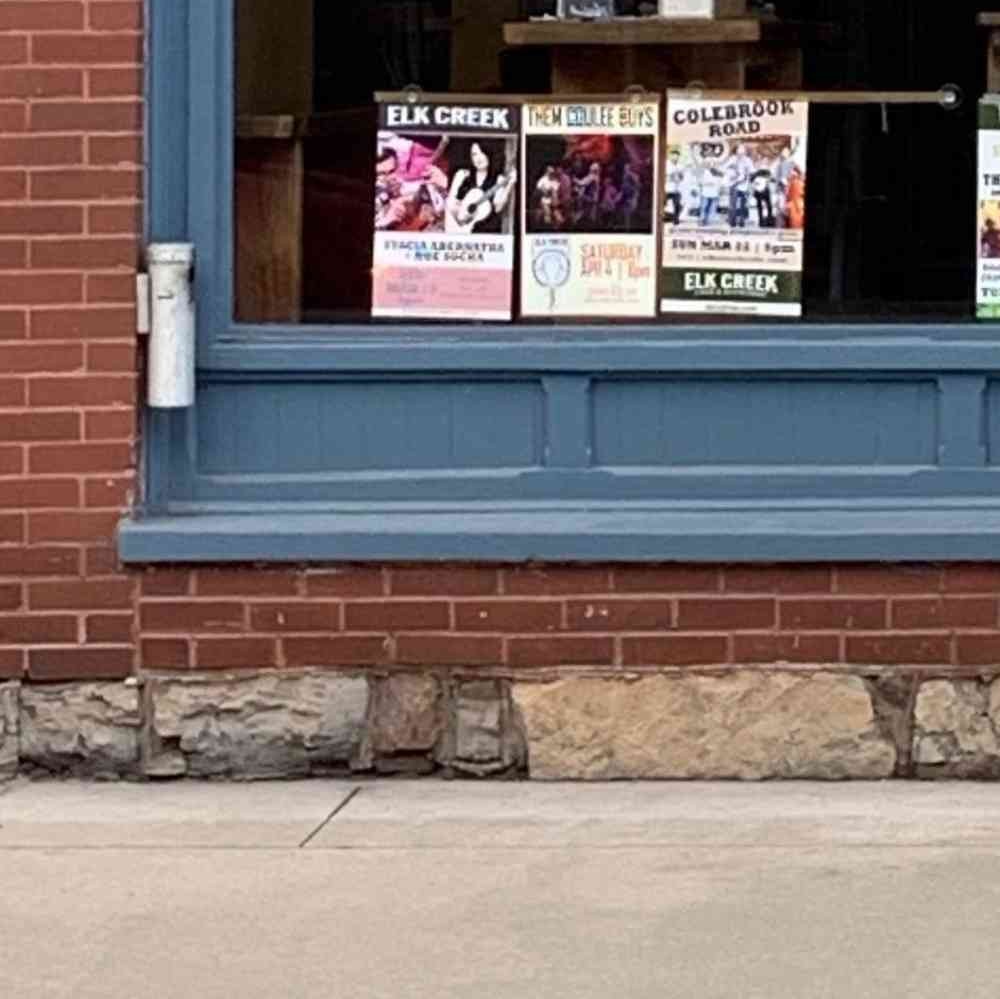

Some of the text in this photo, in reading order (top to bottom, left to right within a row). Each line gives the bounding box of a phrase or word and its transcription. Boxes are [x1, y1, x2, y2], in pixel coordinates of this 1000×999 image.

[387, 105, 509, 129] ELK CREEK
[673, 100, 794, 124] COLEBROOK
[708, 121, 761, 137] ROAD
[684, 272, 717, 291] ELK
[721, 273, 778, 293] CREEK
